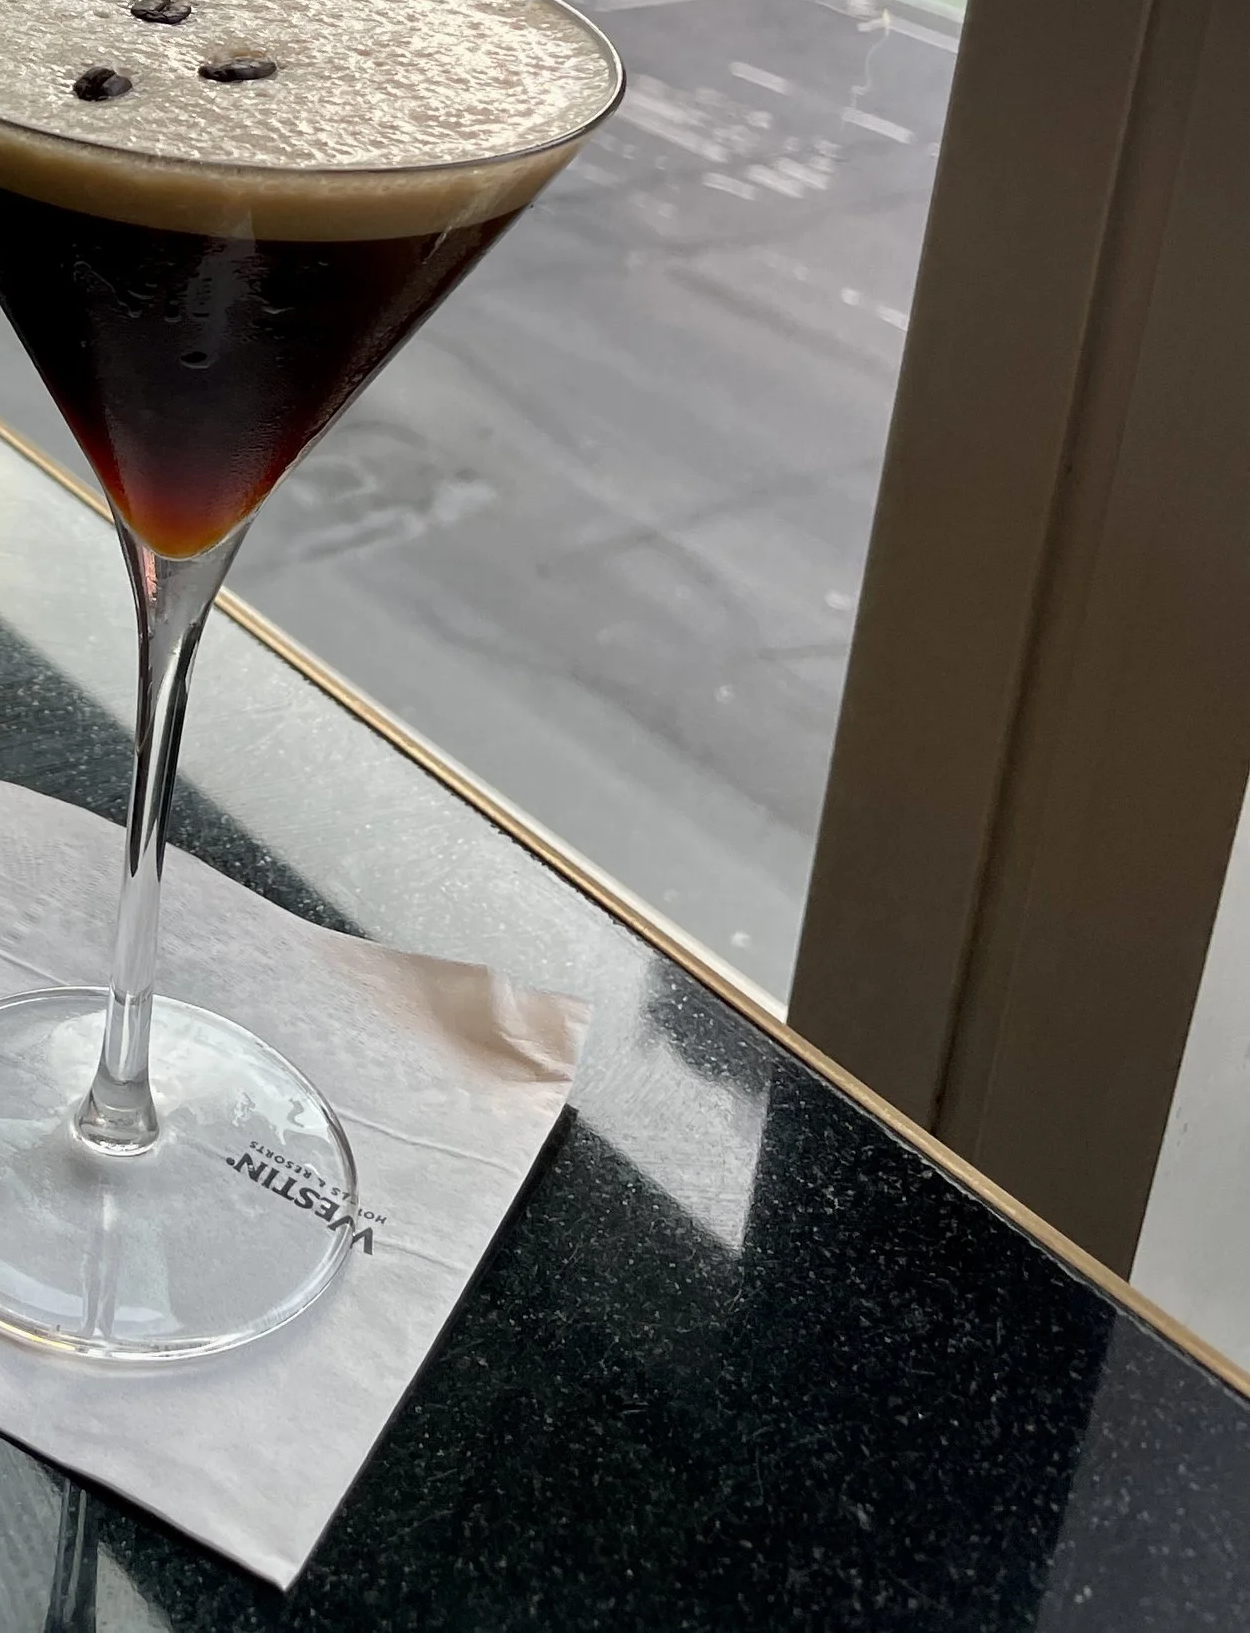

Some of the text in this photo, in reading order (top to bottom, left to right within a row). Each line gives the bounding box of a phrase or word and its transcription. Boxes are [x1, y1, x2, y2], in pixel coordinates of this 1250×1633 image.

[249, 1139, 313, 1179] RESORTS
[232, 1152, 374, 1256] WESTIN
[330, 1185, 388, 1225] HOTLS
